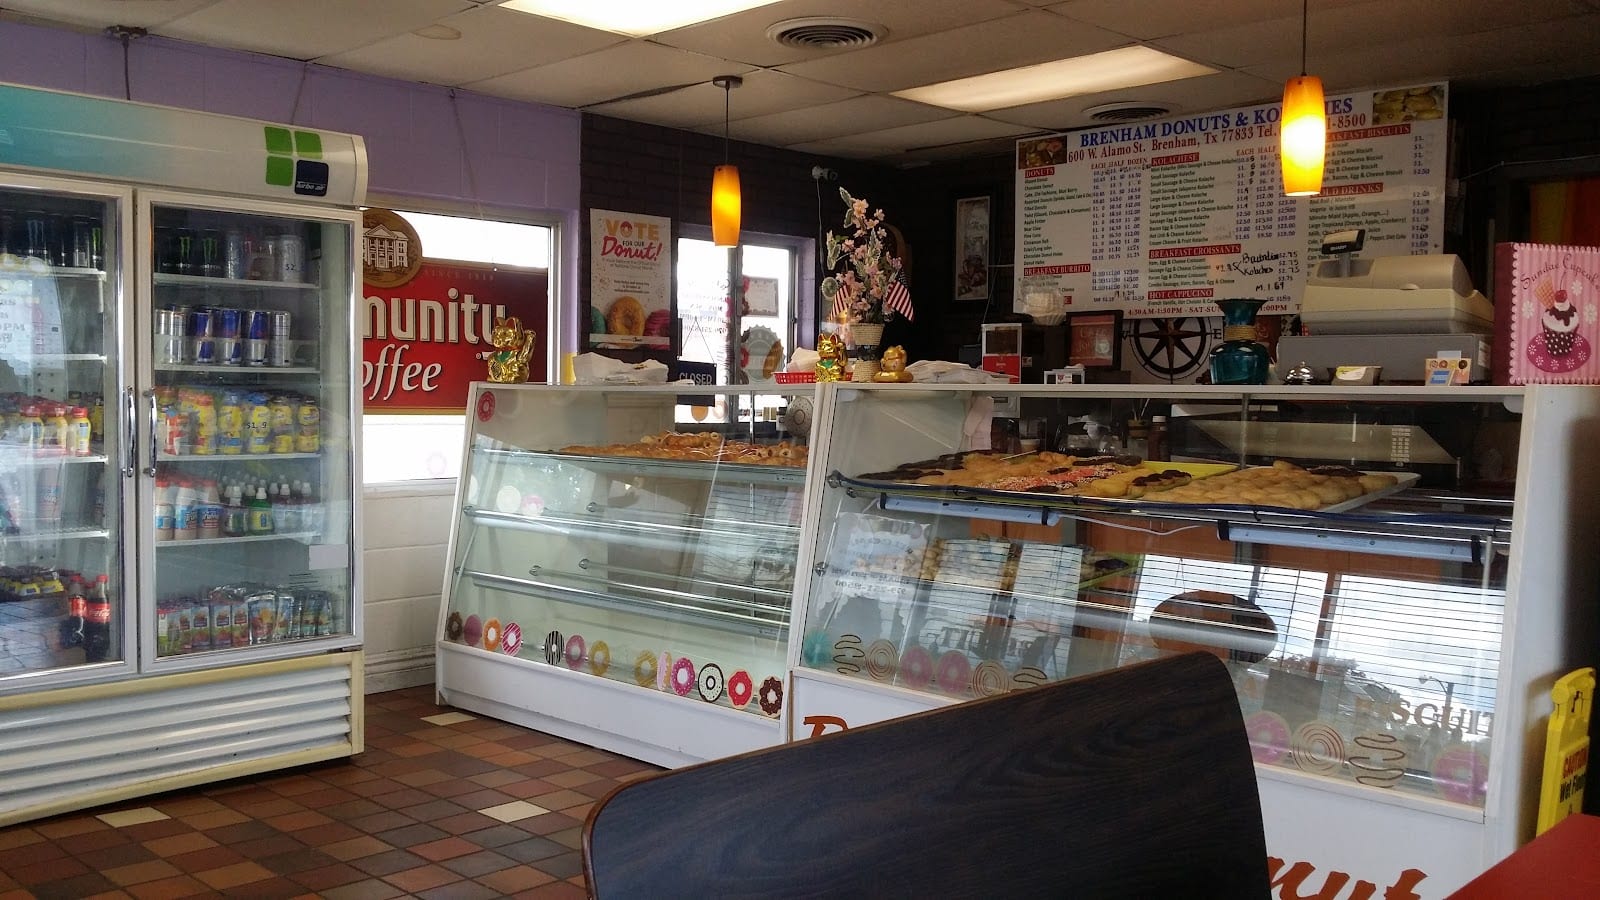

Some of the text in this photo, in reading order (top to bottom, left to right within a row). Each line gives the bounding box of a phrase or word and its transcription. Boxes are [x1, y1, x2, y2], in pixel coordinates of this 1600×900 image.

[1080, 122, 1156, 147] BRENHAM
[1161, 113, 1230, 136] DONUTS
[1235, 111, 1248, 127] &
[1366, 125, 1410, 139] BISCUITS
[1068, 151, 1085, 162] 600
[1088, 148, 1098, 159] W.
[1101, 144, 1131, 158] Alamo
[1133, 141, 1146, 154] St.
[1151, 136, 1200, 151] Brenham,
[1204, 131, 1219, 144] Tx
[1221, 126, 1254, 141] 77833
[1257, 124, 1277, 138] Tel.
[1236, 146, 1277, 157] EACH HALF
[1091, 157, 1148, 170] EACH HALF DOZEN
[1025, 167, 1054, 179] DONUTS
[1341, 183, 1381, 195] DRINKS
[605, 219, 660, 241] VOTE
[601, 235, 663, 262] Donut!
[1149, 244, 1241, 259] BREAKFAST CROISSANTS
[1024, 264, 1091, 276] BREAKFAST BURRITO
[1150, 291, 1166, 299] HOT
[1167, 289, 1213, 298] CAPPUCINO
[1560, 778, 1572, 804] Wet
